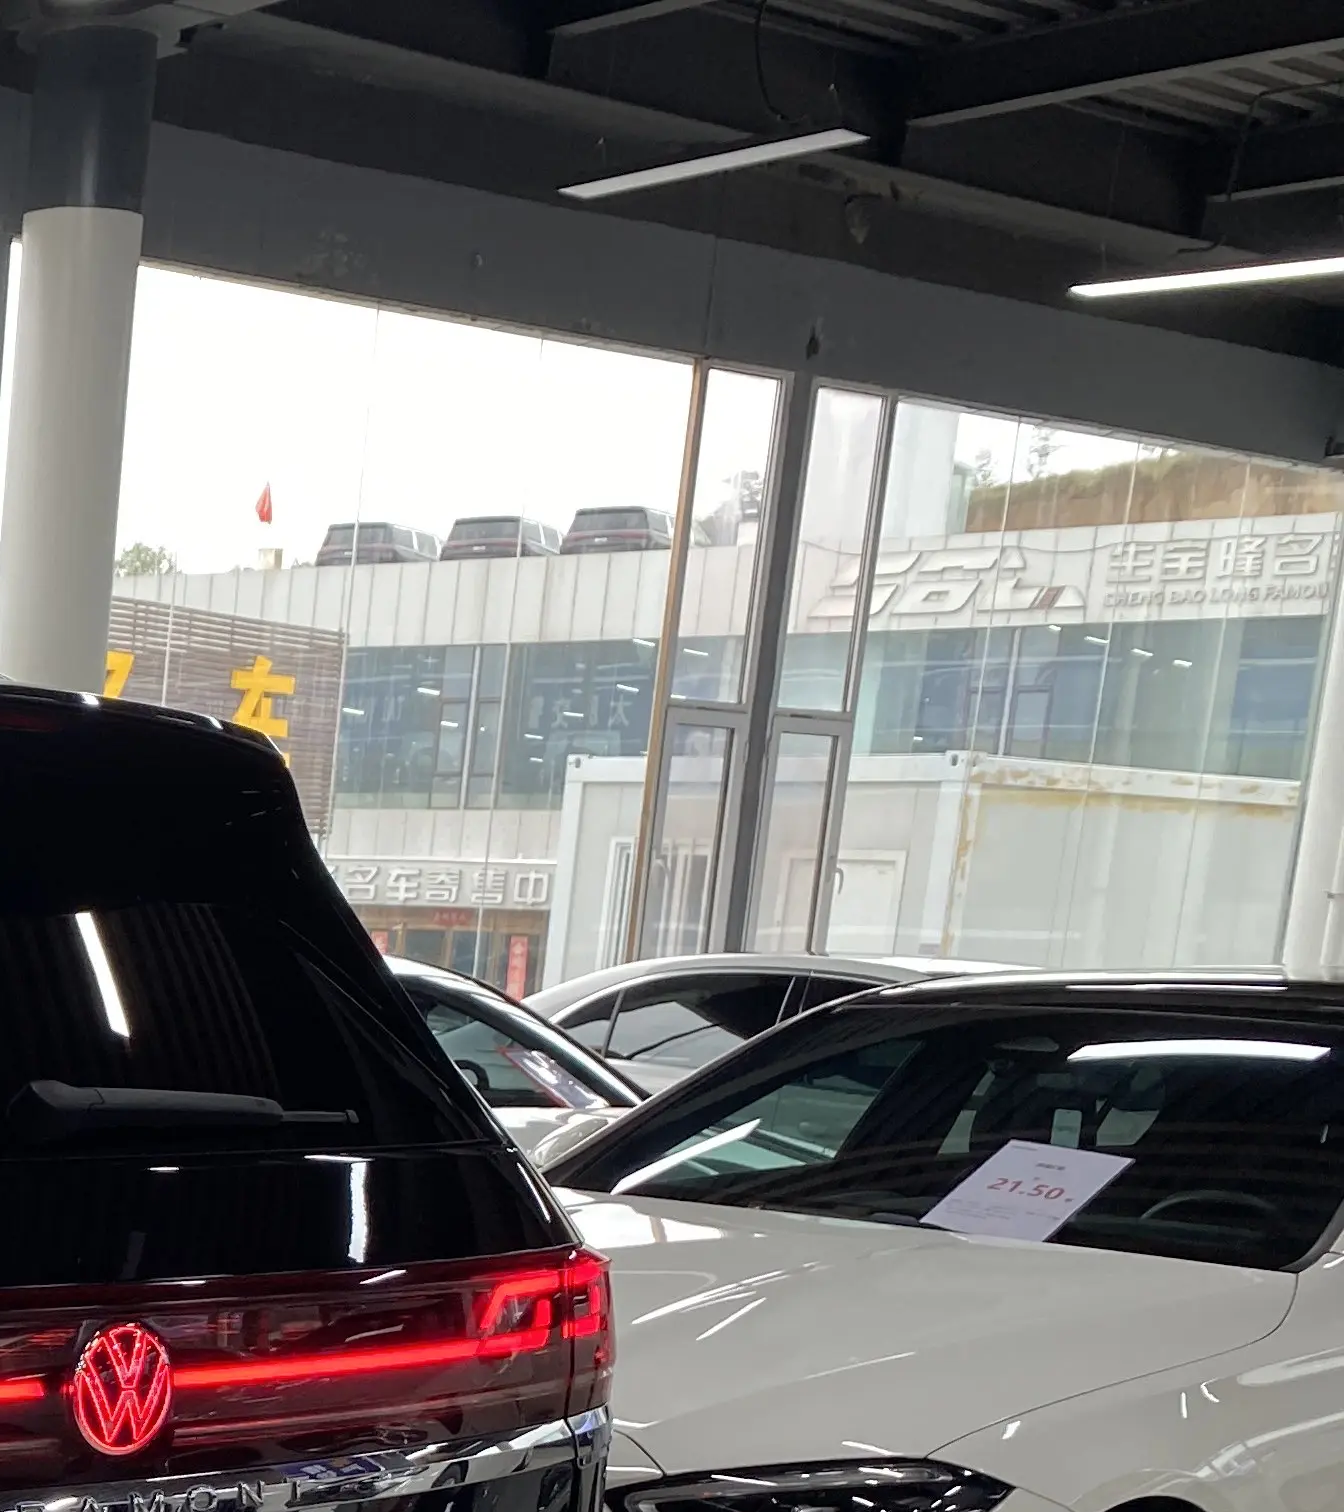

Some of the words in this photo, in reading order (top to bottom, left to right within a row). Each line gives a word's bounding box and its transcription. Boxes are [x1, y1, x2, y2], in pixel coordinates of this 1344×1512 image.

[1106, 531, 1340, 583] 生宝隆名
[1168, 588, 1207, 606] BAO
[1262, 579, 1332, 603] FAMOU
[327, 864, 550, 907] 名车寄售中
[986, 1177, 1065, 1201] 21.50
